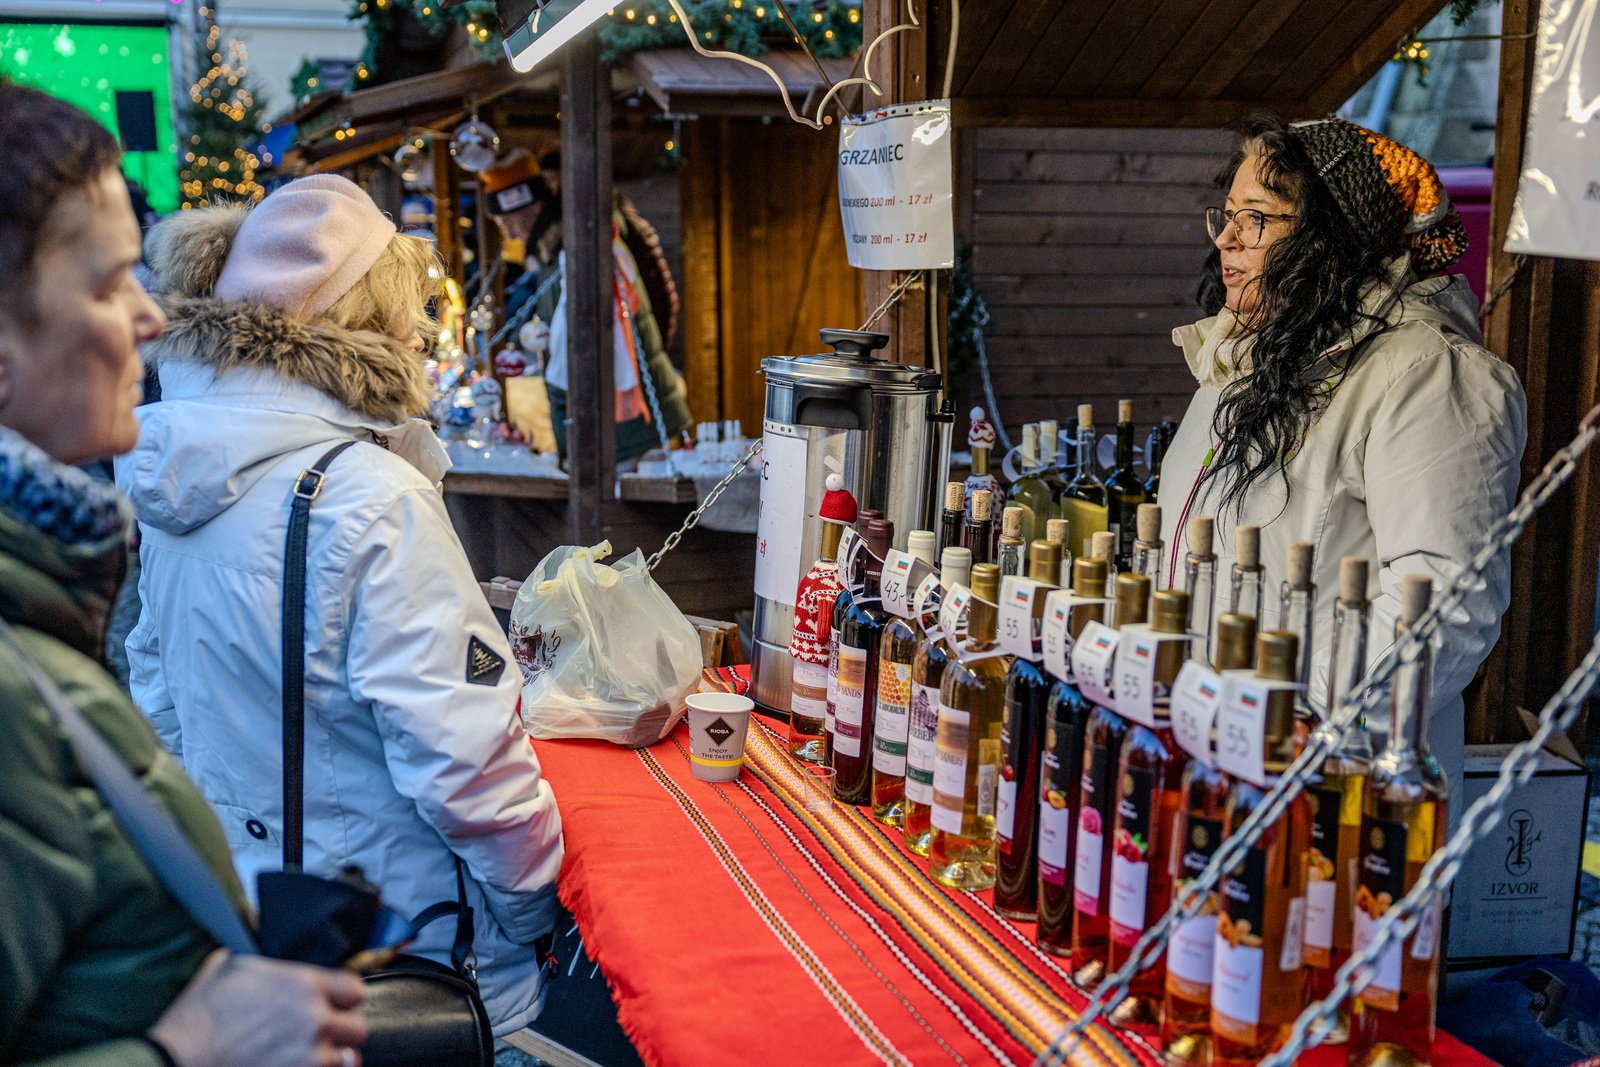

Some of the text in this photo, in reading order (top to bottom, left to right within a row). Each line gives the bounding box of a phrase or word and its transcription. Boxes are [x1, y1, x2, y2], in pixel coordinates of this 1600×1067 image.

[840, 144, 903, 165] GRZANIEC
[870, 196, 884, 208] 200
[885, 195, 896, 207] ml
[908, 194, 920, 205] 17
[870, 234, 882, 245] 200
[883, 234, 893, 244] ml
[904, 233, 916, 243] 17
[918, 232, 927, 243] zł
[1006, 617, 1018, 639] 55
[1123, 673, 1141, 699] 55
[1180, 711, 1198, 741] 55
[1226, 724, 1249, 758] 55
[1491, 882, 1539, 895] IZVOR
